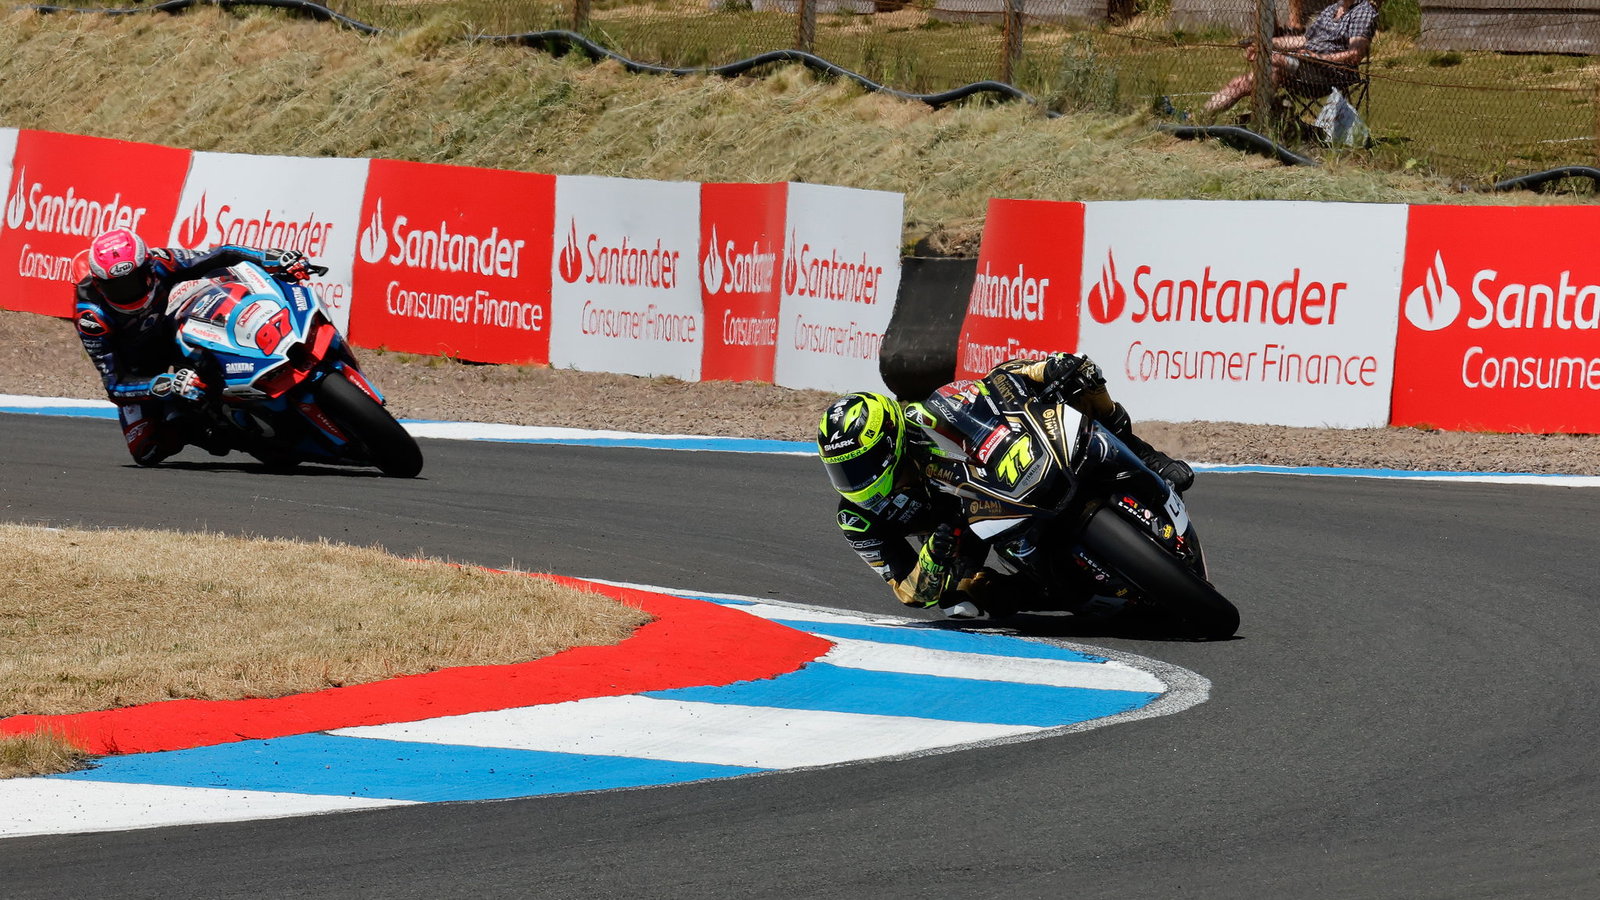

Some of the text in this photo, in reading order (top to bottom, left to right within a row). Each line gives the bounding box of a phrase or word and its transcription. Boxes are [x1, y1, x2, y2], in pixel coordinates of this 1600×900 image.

[25, 182, 146, 237] Santander
[209, 204, 333, 257] Santander
[19, 243, 75, 283] Consum
[110, 261, 131, 274] Arai
[389, 216, 526, 278] Santander
[585, 234, 679, 289] Santander
[798, 243, 883, 304] Santander
[1131, 265, 1348, 326] Santander
[386, 281, 474, 324] Consumer
[475, 290, 543, 332] Finance
[582, 300, 696, 342] Consumer Finance
[1467, 269, 1600, 329] Santa
[255, 307, 293, 357] 97
[795, 314, 849, 356] Consumer
[1125, 341, 1258, 384] Consumer
[1262, 343, 1377, 387] Finance
[1462, 346, 1600, 390] Consume
[823, 438, 855, 452] SHARK
[1044, 418, 1056, 440] LAMI
[996, 434, 1032, 485] 77
